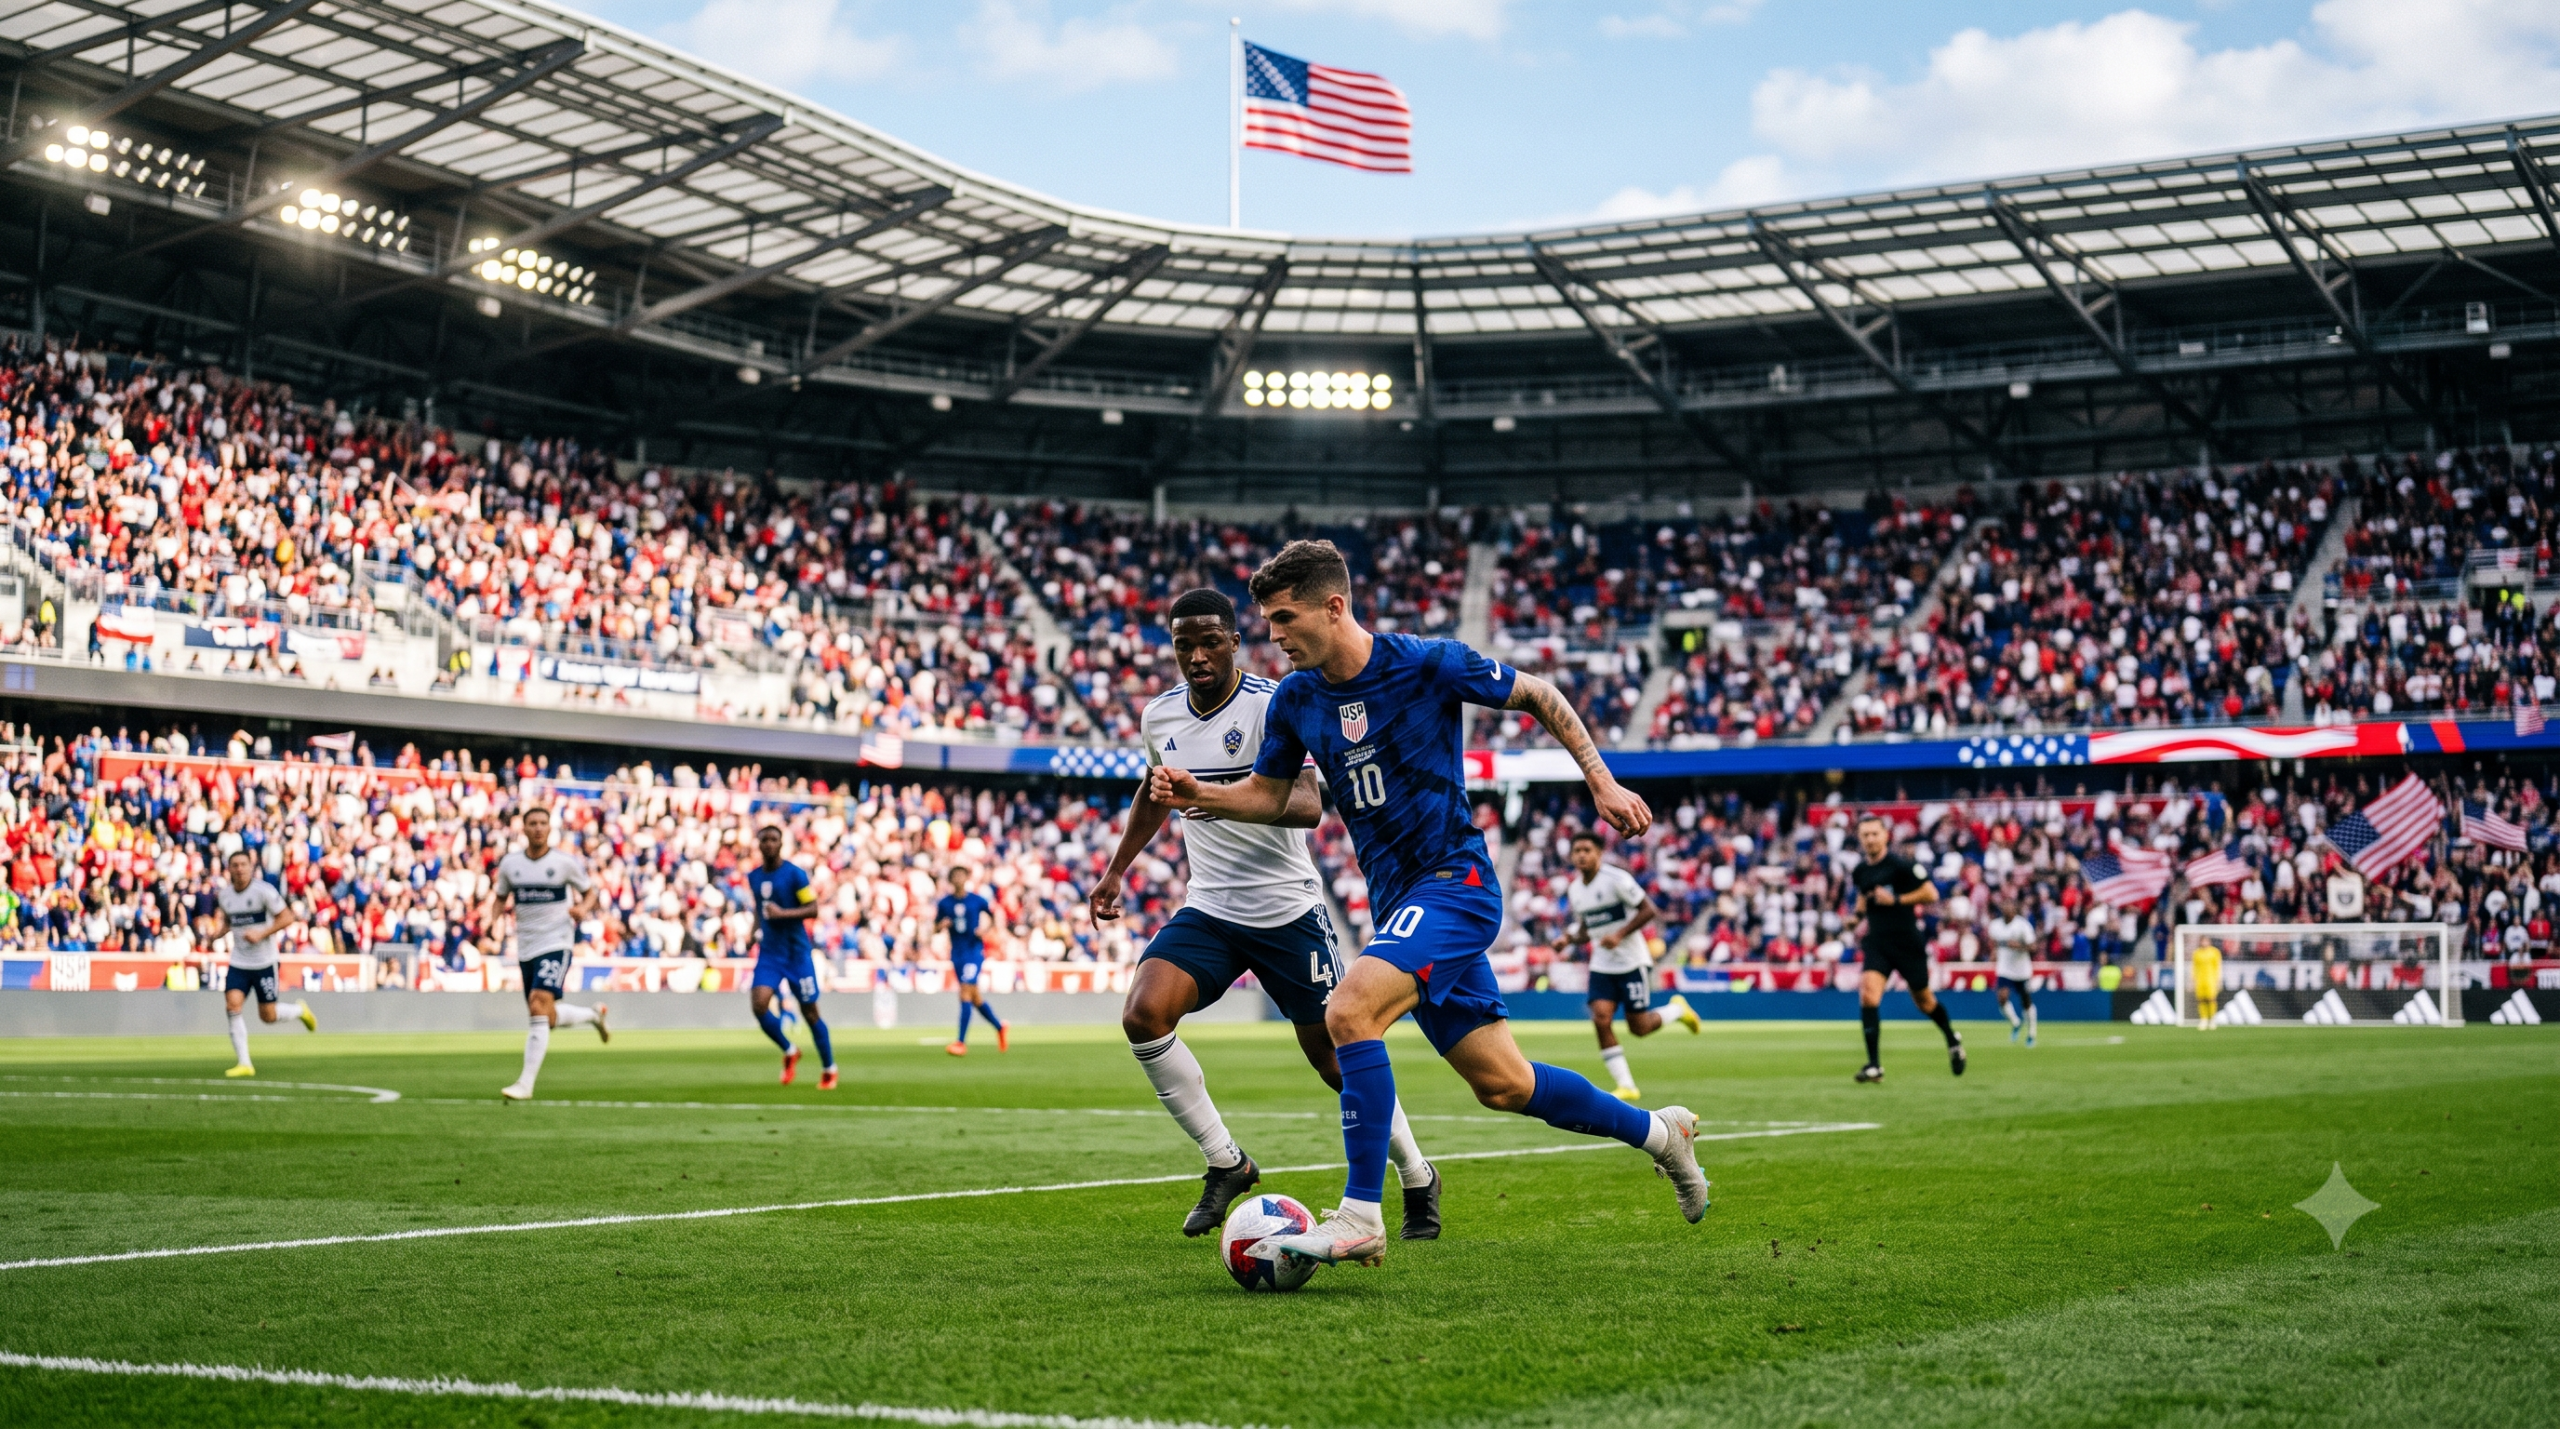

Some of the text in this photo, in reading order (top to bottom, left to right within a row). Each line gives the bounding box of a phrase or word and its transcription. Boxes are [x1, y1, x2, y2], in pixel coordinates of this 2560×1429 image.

[1341, 703, 1364, 721] USA
[1348, 763, 1387, 809] 10
[1310, 951, 1333, 987] 4
